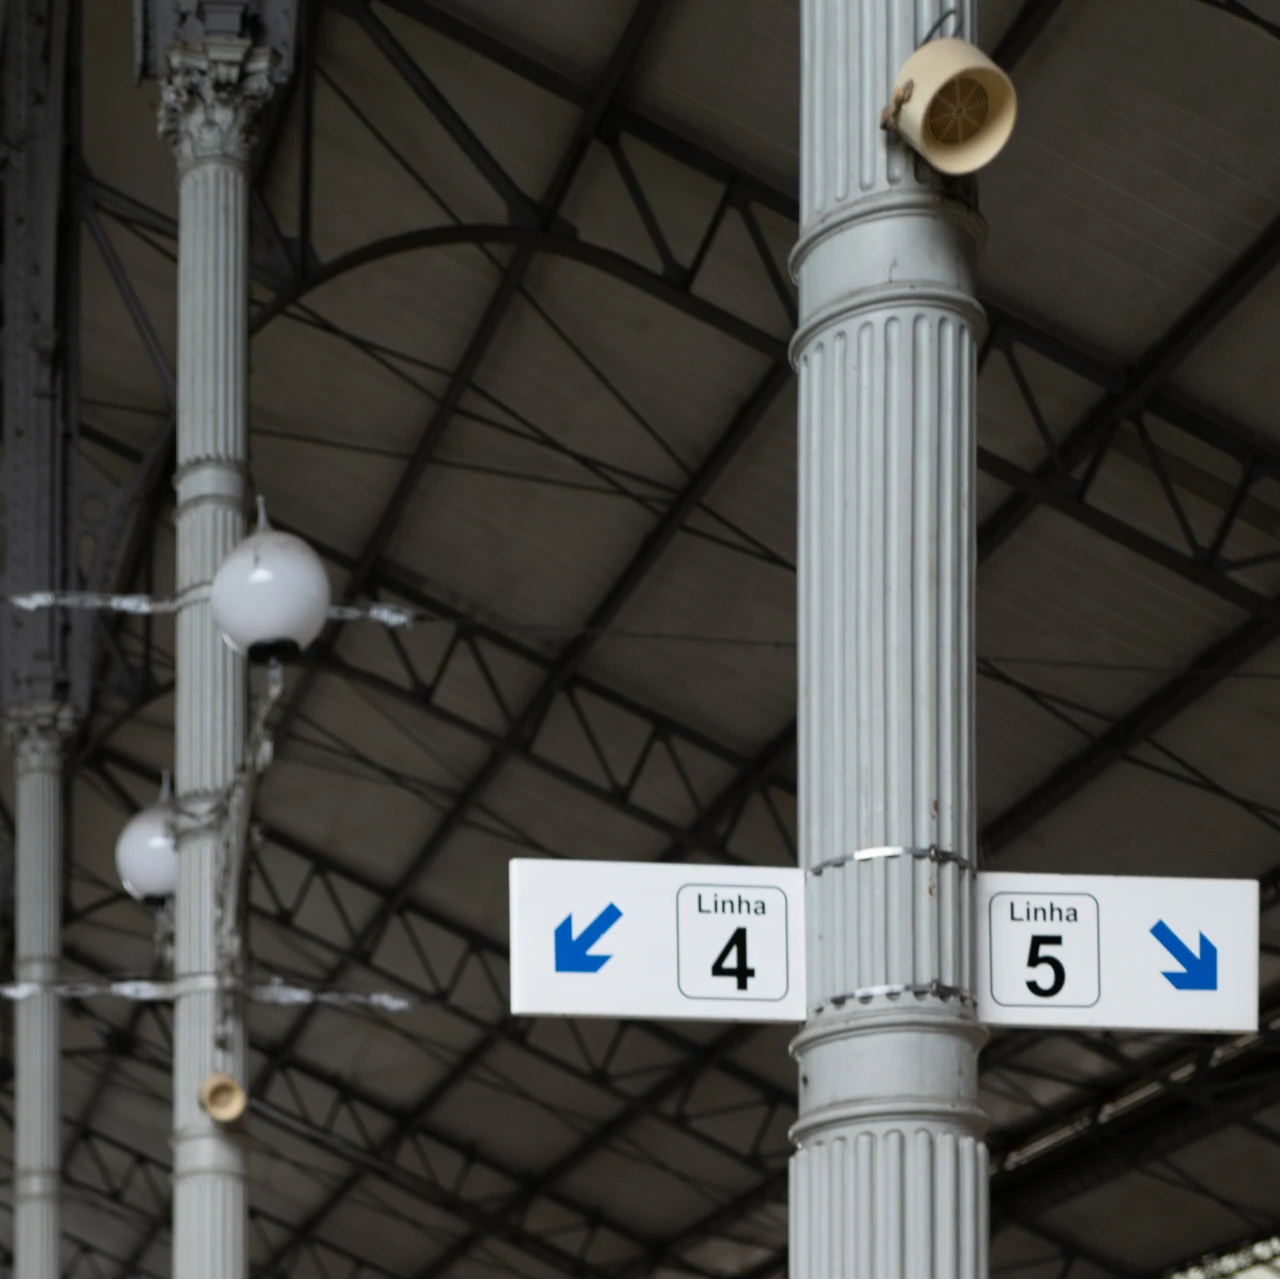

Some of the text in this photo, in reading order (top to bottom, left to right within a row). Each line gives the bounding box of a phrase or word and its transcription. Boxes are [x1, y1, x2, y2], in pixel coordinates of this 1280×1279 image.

[697, 893, 766, 915] Linha
[1010, 901, 1078, 922] Linha
[711, 926, 755, 991] 4
[1025, 934, 1066, 998] 5
